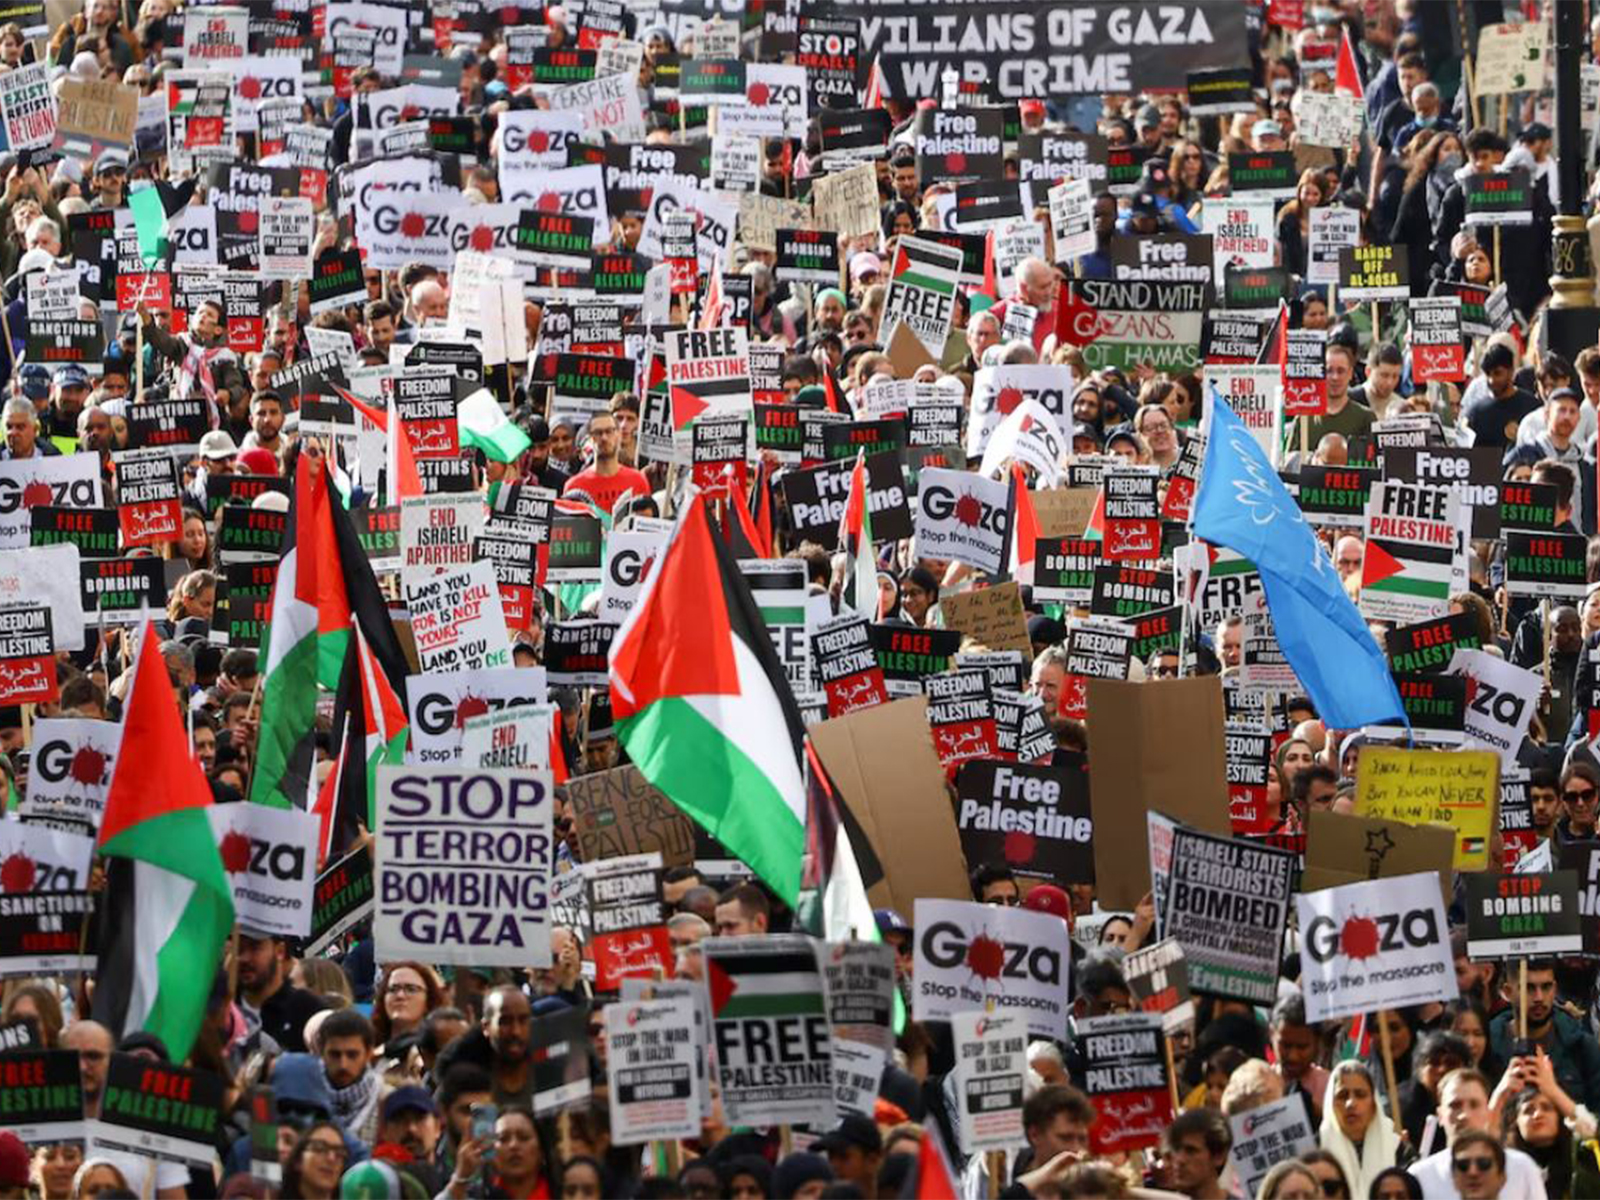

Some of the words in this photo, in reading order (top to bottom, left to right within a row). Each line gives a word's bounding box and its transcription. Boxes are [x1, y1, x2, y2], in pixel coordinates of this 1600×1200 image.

[207, 20, 226, 30] END
[1048, 9, 1096, 45] OF
[1108, 7, 1213, 44] GAZA
[552, 52, 578, 65] FREE
[1000, 54, 1131, 97] CRIME
[934, 113, 976, 133] Free
[916, 134, 999, 155] Palestine
[1042, 139, 1087, 158] Free
[631, 147, 674, 168] Free
[230, 168, 271, 190] Free
[1484, 180, 1508, 191] FREE
[1469, 191, 1523, 204] PALESTINE
[539, 217, 571, 234] FREE
[1227, 211, 1248, 223] END
[519, 228, 591, 251] PALESTINE
[1139, 241, 1187, 262] Free
[1355, 247, 1392, 260] HANDS
[1363, 261, 1382, 273] OFF
[1350, 273, 1398, 287] AL-AQSA
[888, 284, 952, 321] FREE
[1082, 282, 1149, 306] STAND
[1156, 285, 1204, 309] WITH
[574, 306, 619, 321] FREEDOM
[1414, 309, 1457, 323] FREEDOM
[30, 322, 96, 336] SANCTIONS
[573, 326, 622, 342] PALESTINE
[1212, 323, 1258, 338] FREEDOM
[1413, 329, 1461, 344] PALESTINE
[56, 336, 72, 347] ON
[677, 329, 735, 359] FREE
[1210, 341, 1261, 356] PALESTINE
[1124, 343, 1197, 366] HAMAS
[270, 355, 338, 388] SANCTIONS
[579, 359, 612, 376] FREE
[671, 359, 748, 380] PALESTINE
[400, 378, 451, 396] FREEDOM
[556, 375, 634, 395] PALESTINE
[1231, 378, 1255, 396] END
[131, 402, 200, 420] SANCTIONS
[399, 401, 456, 418] PALESTINE
[766, 411, 797, 428] FREE
[912, 408, 957, 424] FREEDOM
[160, 418, 176, 431] ON
[698, 424, 742, 440] FREEDOM
[909, 431, 958, 446] PALESTINE
[1378, 432, 1426, 447] FREEDOM
[695, 444, 744, 460] PALESTINE
[121, 461, 171, 479] FREEDOM
[1416, 452, 1470, 477] Free
[231, 481, 267, 496] FREE
[1108, 478, 1152, 493] FREEDOM
[1325, 472, 1360, 488] FREE
[121, 481, 176, 501] PALESTINE
[1106, 500, 1156, 517] PALESTINE
[1382, 485, 1448, 521] FREE
[57, 513, 93, 530] FREE
[249, 513, 284, 529] FREE
[429, 507, 456, 526] END
[32, 530, 116, 549] PALESTINE
[418, 528, 468, 546] ISRAELI
[920, 528, 945, 544] Stop
[949, 531, 967, 548] the
[1371, 518, 1453, 544] PALESTINE
[478, 543, 531, 561] FREEDOM
[1060, 540, 1096, 555] STOP
[1530, 539, 1563, 557] FREE
[100, 562, 134, 576] STOP
[1508, 556, 1584, 575] PALESTINE
[85, 577, 150, 591] BOMBING
[406, 583, 440, 601] LAND
[445, 573, 470, 591] YOU
[1118, 570, 1157, 584] STOP
[101, 591, 136, 607] GAZA
[409, 596, 441, 616] HAVE
[445, 592, 459, 606] TO
[463, 584, 490, 602] KILL
[1102, 582, 1171, 603] BOMBING
[412, 614, 437, 632] FOR
[440, 609, 451, 622] IS
[453, 601, 480, 619] NOT
[816, 623, 869, 652] FREEDOM
[891, 632, 932, 652] FREE
[1073, 632, 1128, 651] FREEDOM
[1412, 624, 1452, 646] FREE
[421, 649, 457, 671] LAND
[459, 639, 486, 659] YOU
[580, 642, 598, 655] ON
[1392, 636, 1480, 673] PALESTINE
[820, 649, 878, 681] PALESTINE
[1067, 658, 1127, 679] PALESTINE
[925, 671, 985, 695] FREEDOM
[925, 698, 991, 721] PALESTINE
[491, 725, 517, 749] END
[420, 748, 450, 762] Stop
[479, 744, 528, 768] ISRAELI
[993, 767, 1061, 802] Free
[388, 774, 545, 820] STOP
[959, 800, 1093, 843] Palestine
[383, 831, 549, 864] TERROR
[1180, 836, 1237, 866] ISRAELI
[1241, 849, 1287, 875] STATE
[593, 873, 656, 901] FREEDOM
[1176, 858, 1285, 899] TERRORISTS
[1498, 878, 1542, 897] STOP
[234, 886, 302, 911] massacre
[381, 871, 548, 911] BOMBING
[1, 896, 95, 916] SANCTIONS
[1174, 883, 1280, 930] BOMBED
[1483, 896, 1562, 917] BOMBING
[38, 914, 62, 932] ON
[594, 903, 663, 932] PALESTINE
[1501, 914, 1546, 934] GAZA
[400, 910, 525, 947] GAZA
[1305, 907, 1440, 964] Gza
[921, 921, 1061, 986] Gza
[1369, 960, 1445, 984] massacre
[921, 981, 958, 999] Stop
[960, 986, 982, 1004] the
[986, 991, 1060, 1014] massacre
[715, 1017, 831, 1066] FREE
[1086, 1033, 1157, 1059] FREEDOM
[141, 1068, 192, 1101] FREE
[720, 1063, 832, 1089] PALESTINE
[1087, 1064, 1166, 1092] PALESTINE
[104, 1086, 218, 1132] PALESTINE
